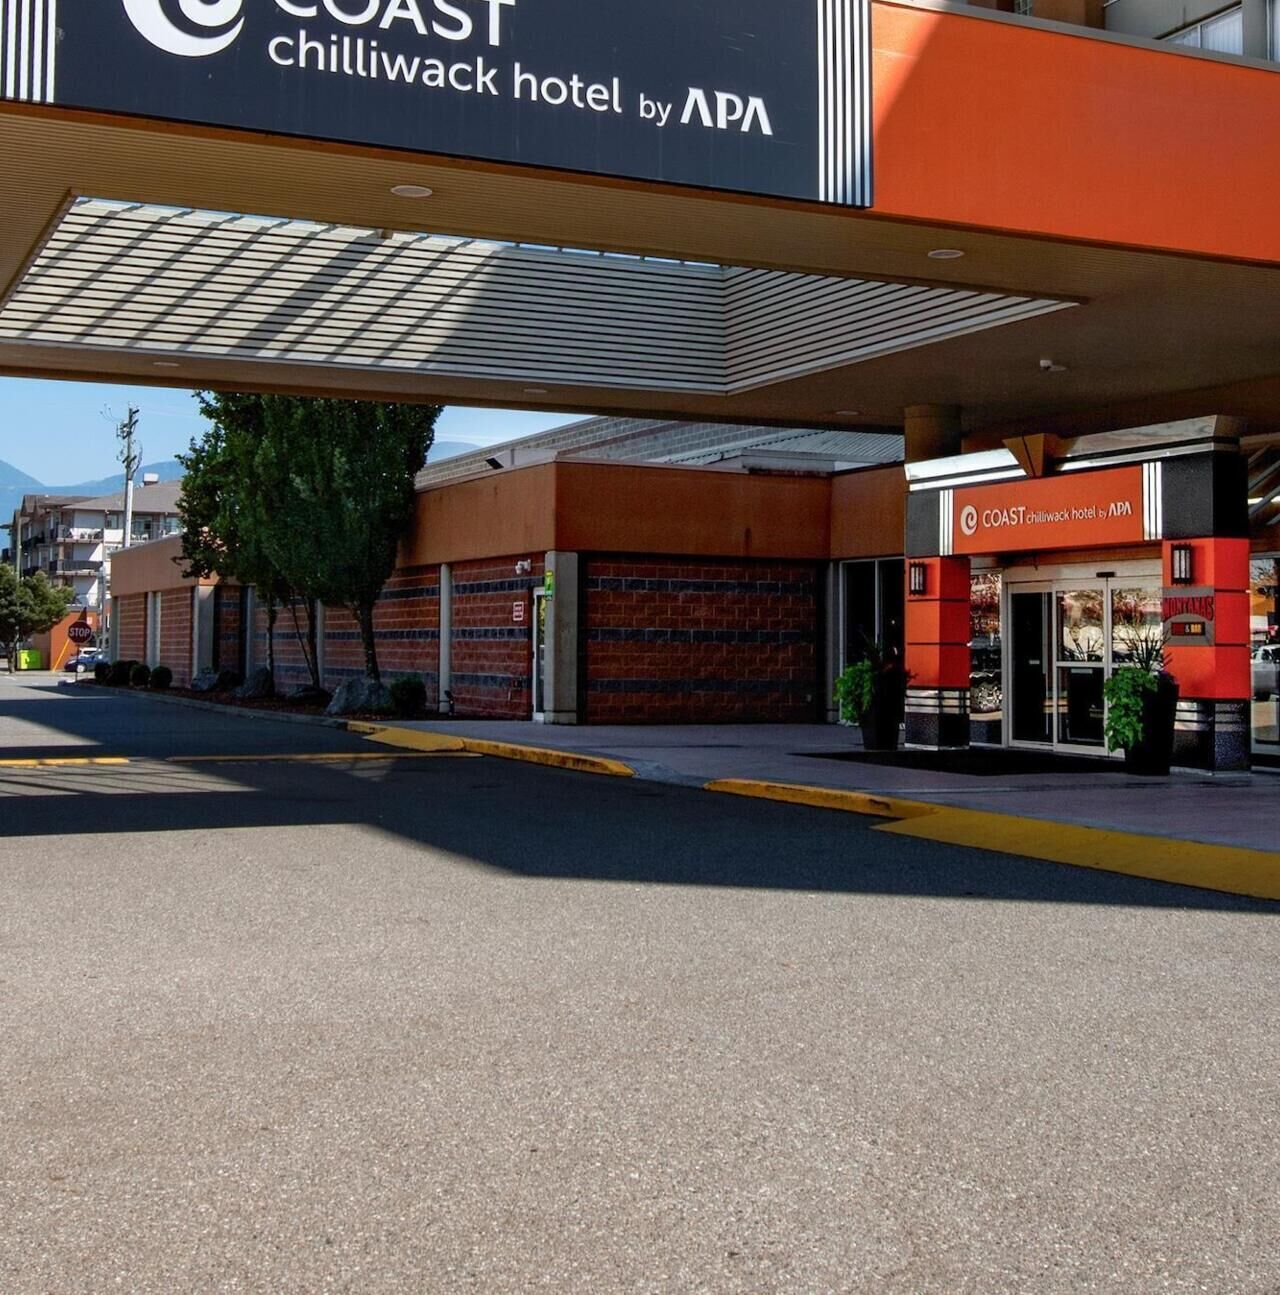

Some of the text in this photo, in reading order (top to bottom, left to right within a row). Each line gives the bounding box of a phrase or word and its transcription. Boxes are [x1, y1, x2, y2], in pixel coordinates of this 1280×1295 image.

[268, 29, 773, 136] chilliwack hotel by APA
[982, 501, 1132, 528] COAST chilliwack hotel by APA
[69, 627, 91, 637] STOP
